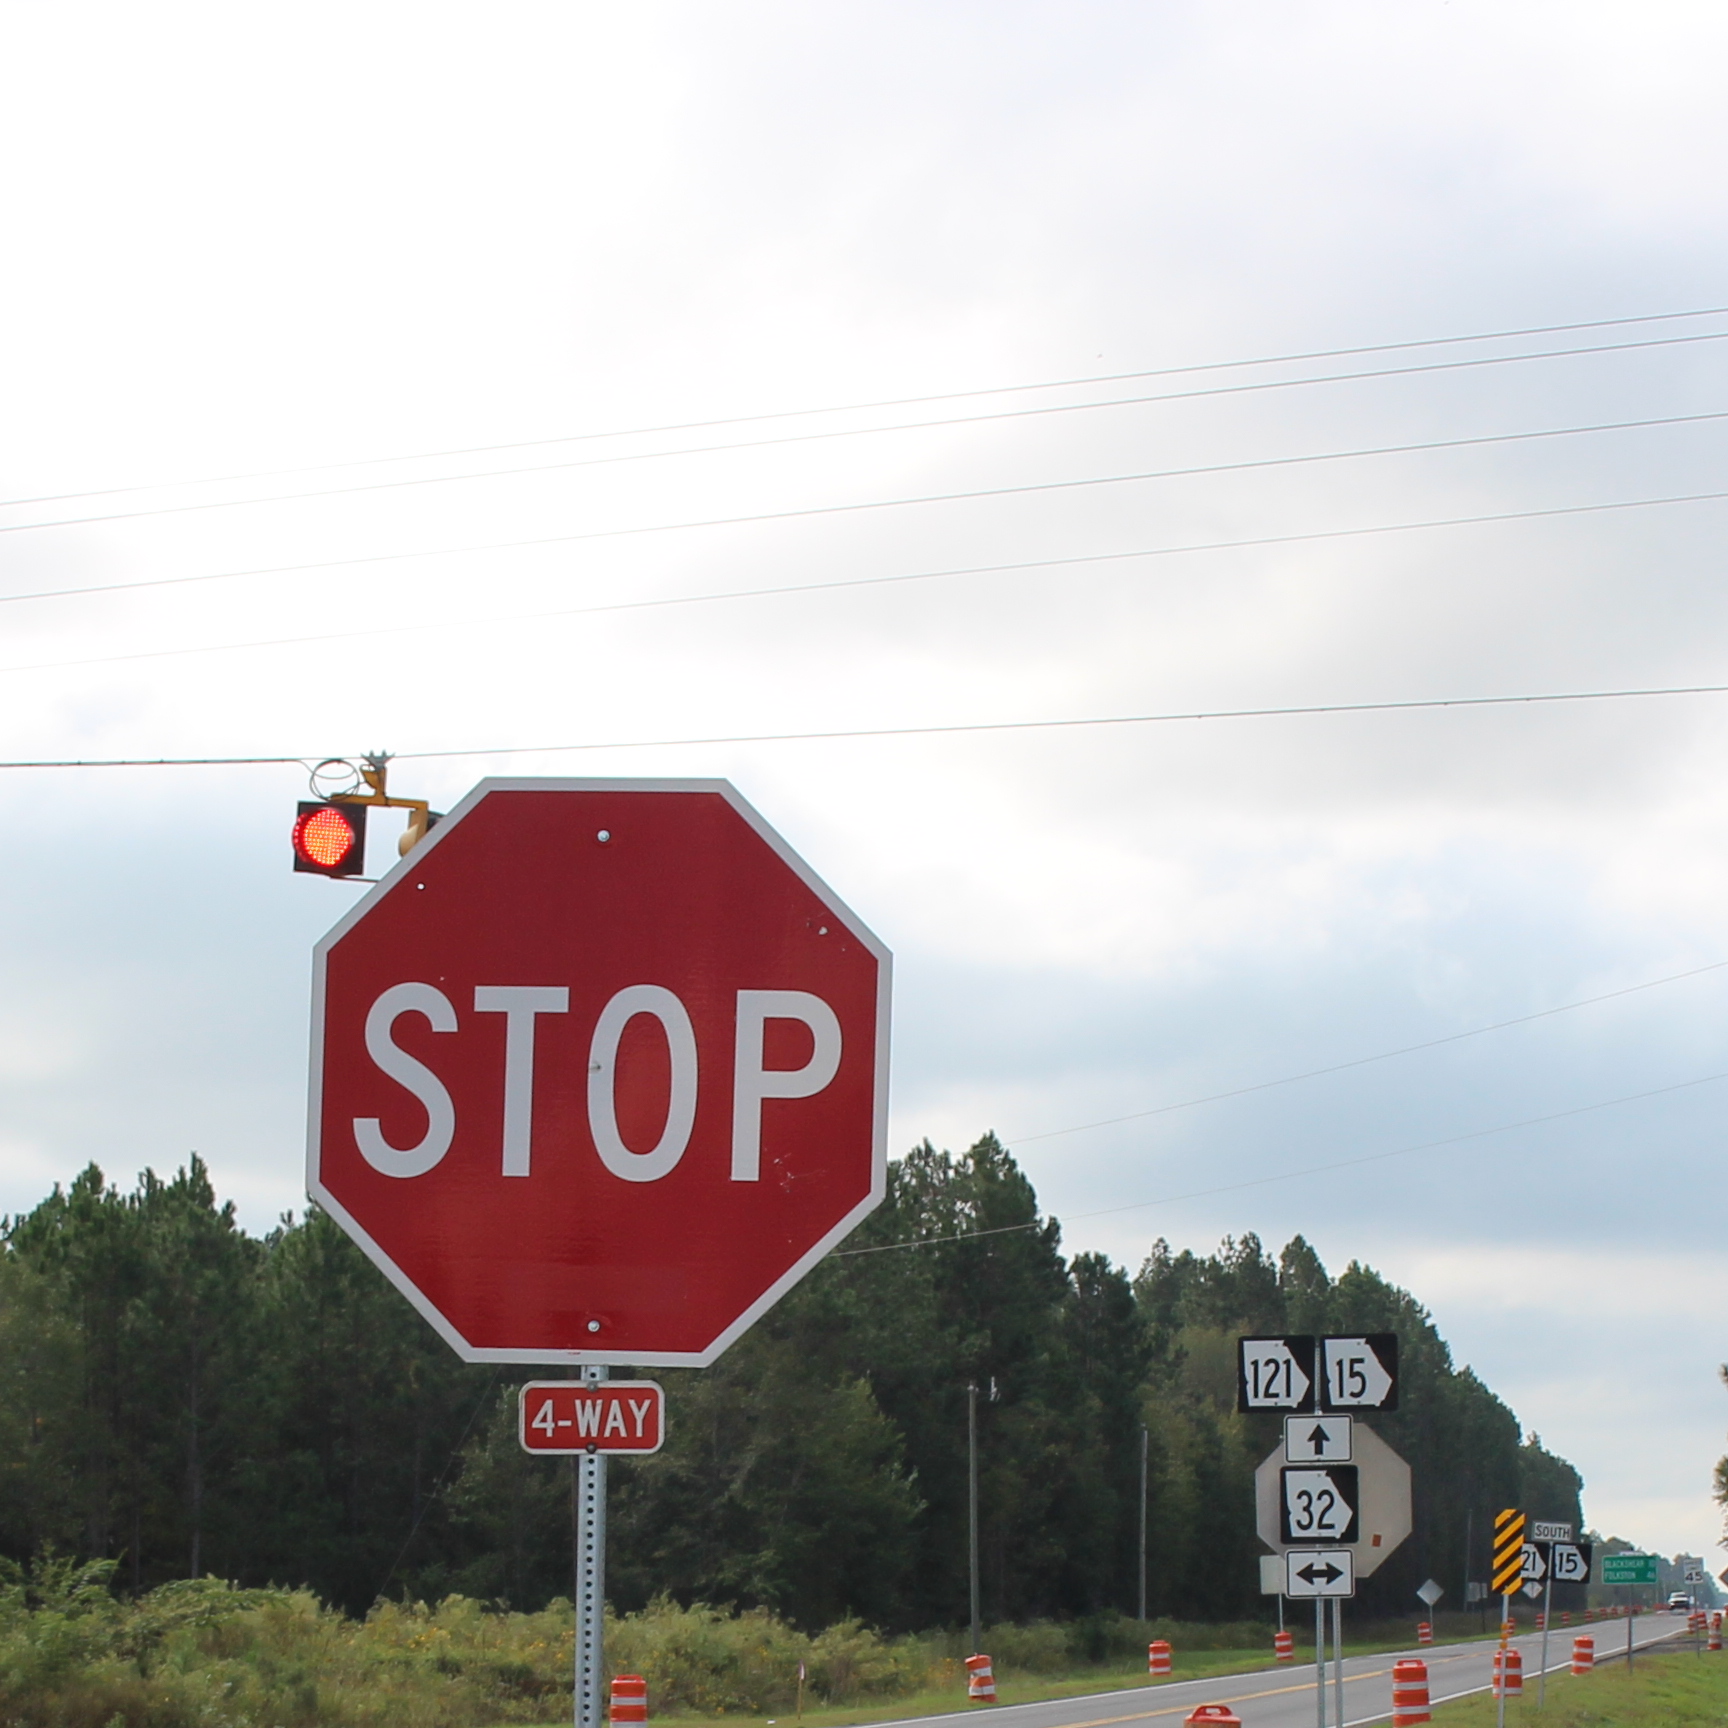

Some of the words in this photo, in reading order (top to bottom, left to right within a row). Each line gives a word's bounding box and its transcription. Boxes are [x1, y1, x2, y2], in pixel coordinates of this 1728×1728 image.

[352, 981, 843, 1183] STOP
[1250, 1358, 1292, 1399] 121
[1335, 1357, 1367, 1398] 15
[531, 1399, 652, 1438] 4-WAY
[1295, 1489, 1335, 1530] 32
[1535, 1524, 1570, 1538] SOUTH
[1522, 1550, 1536, 1572] 21
[1558, 1553, 1578, 1573] 15
[1684, 1571, 1703, 1581] 45
